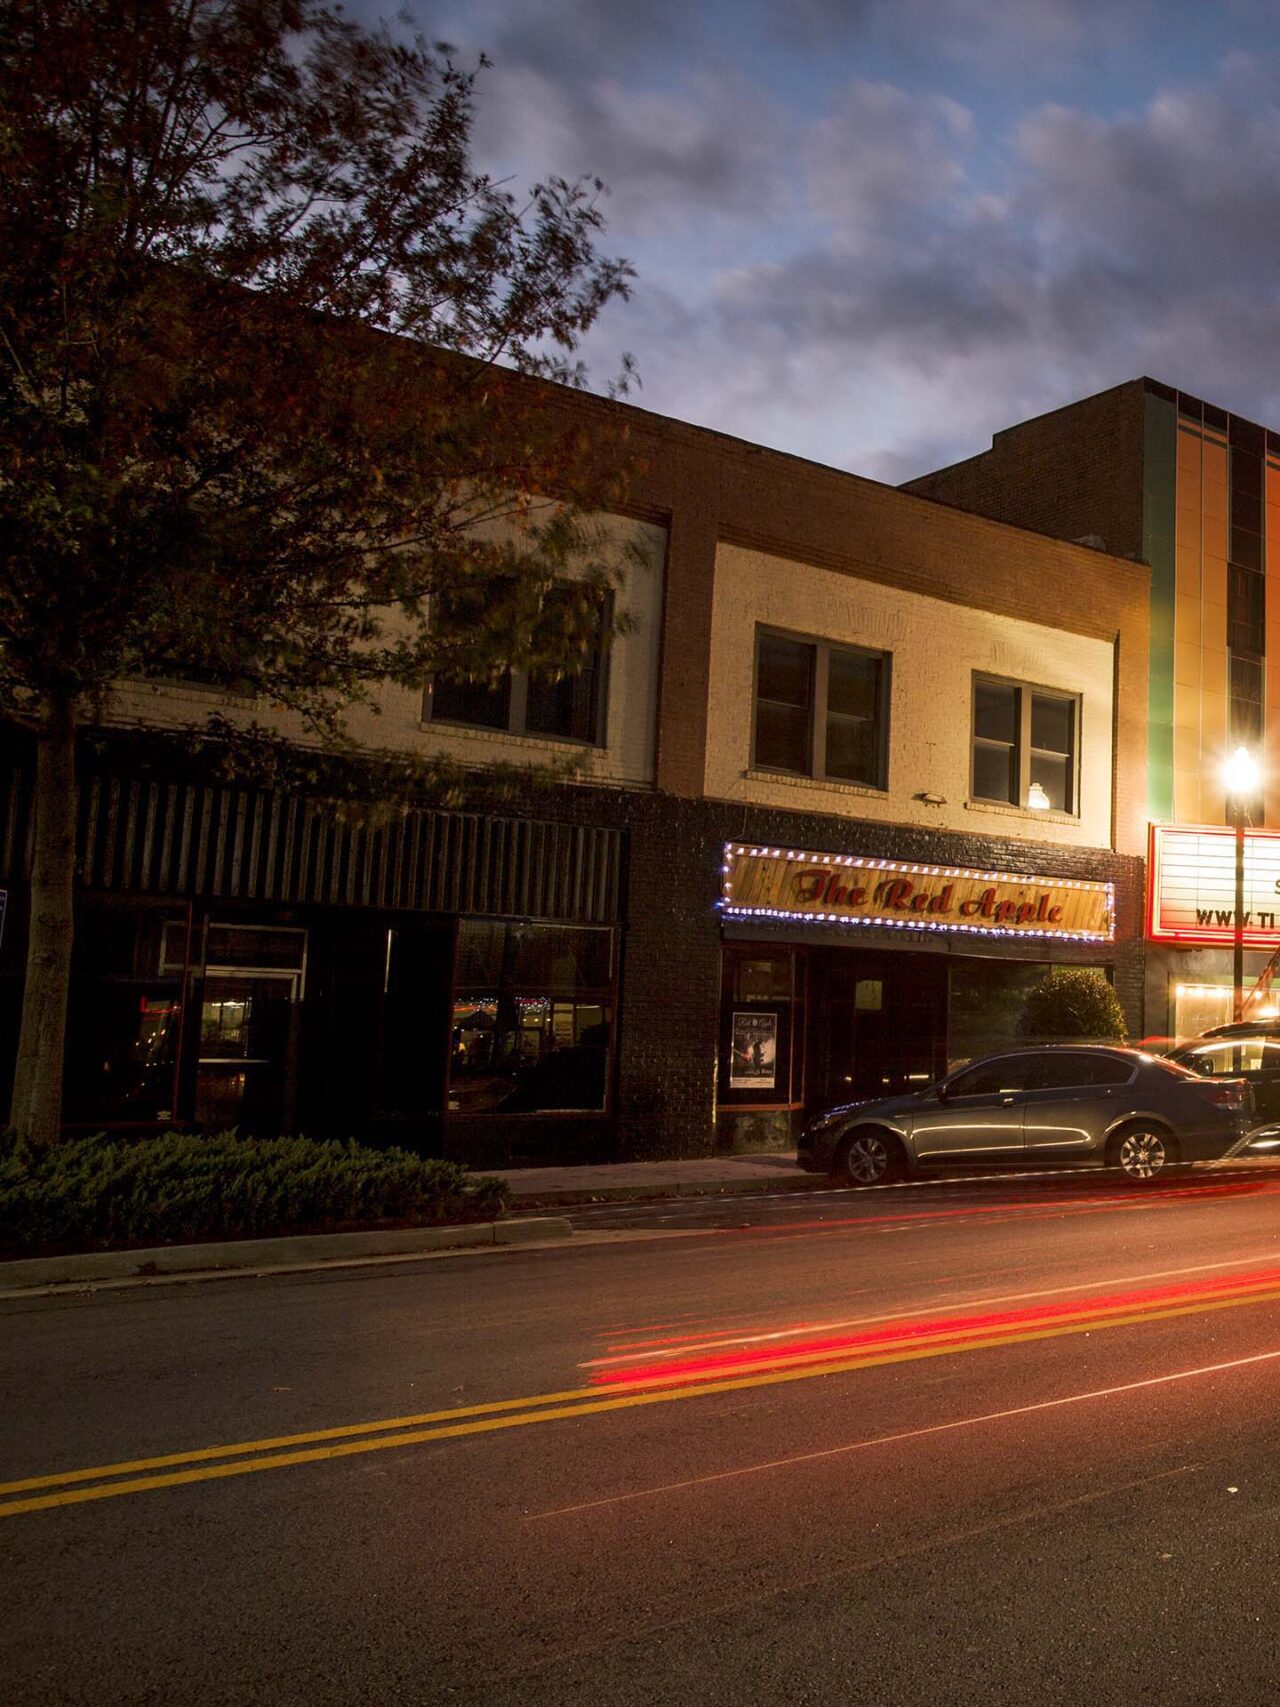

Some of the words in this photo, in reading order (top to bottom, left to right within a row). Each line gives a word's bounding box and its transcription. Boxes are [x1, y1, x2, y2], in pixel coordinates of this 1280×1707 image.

[793, 869, 867, 906] The
[874, 878, 954, 915] Red
[959, 887, 1063, 924] Apple
